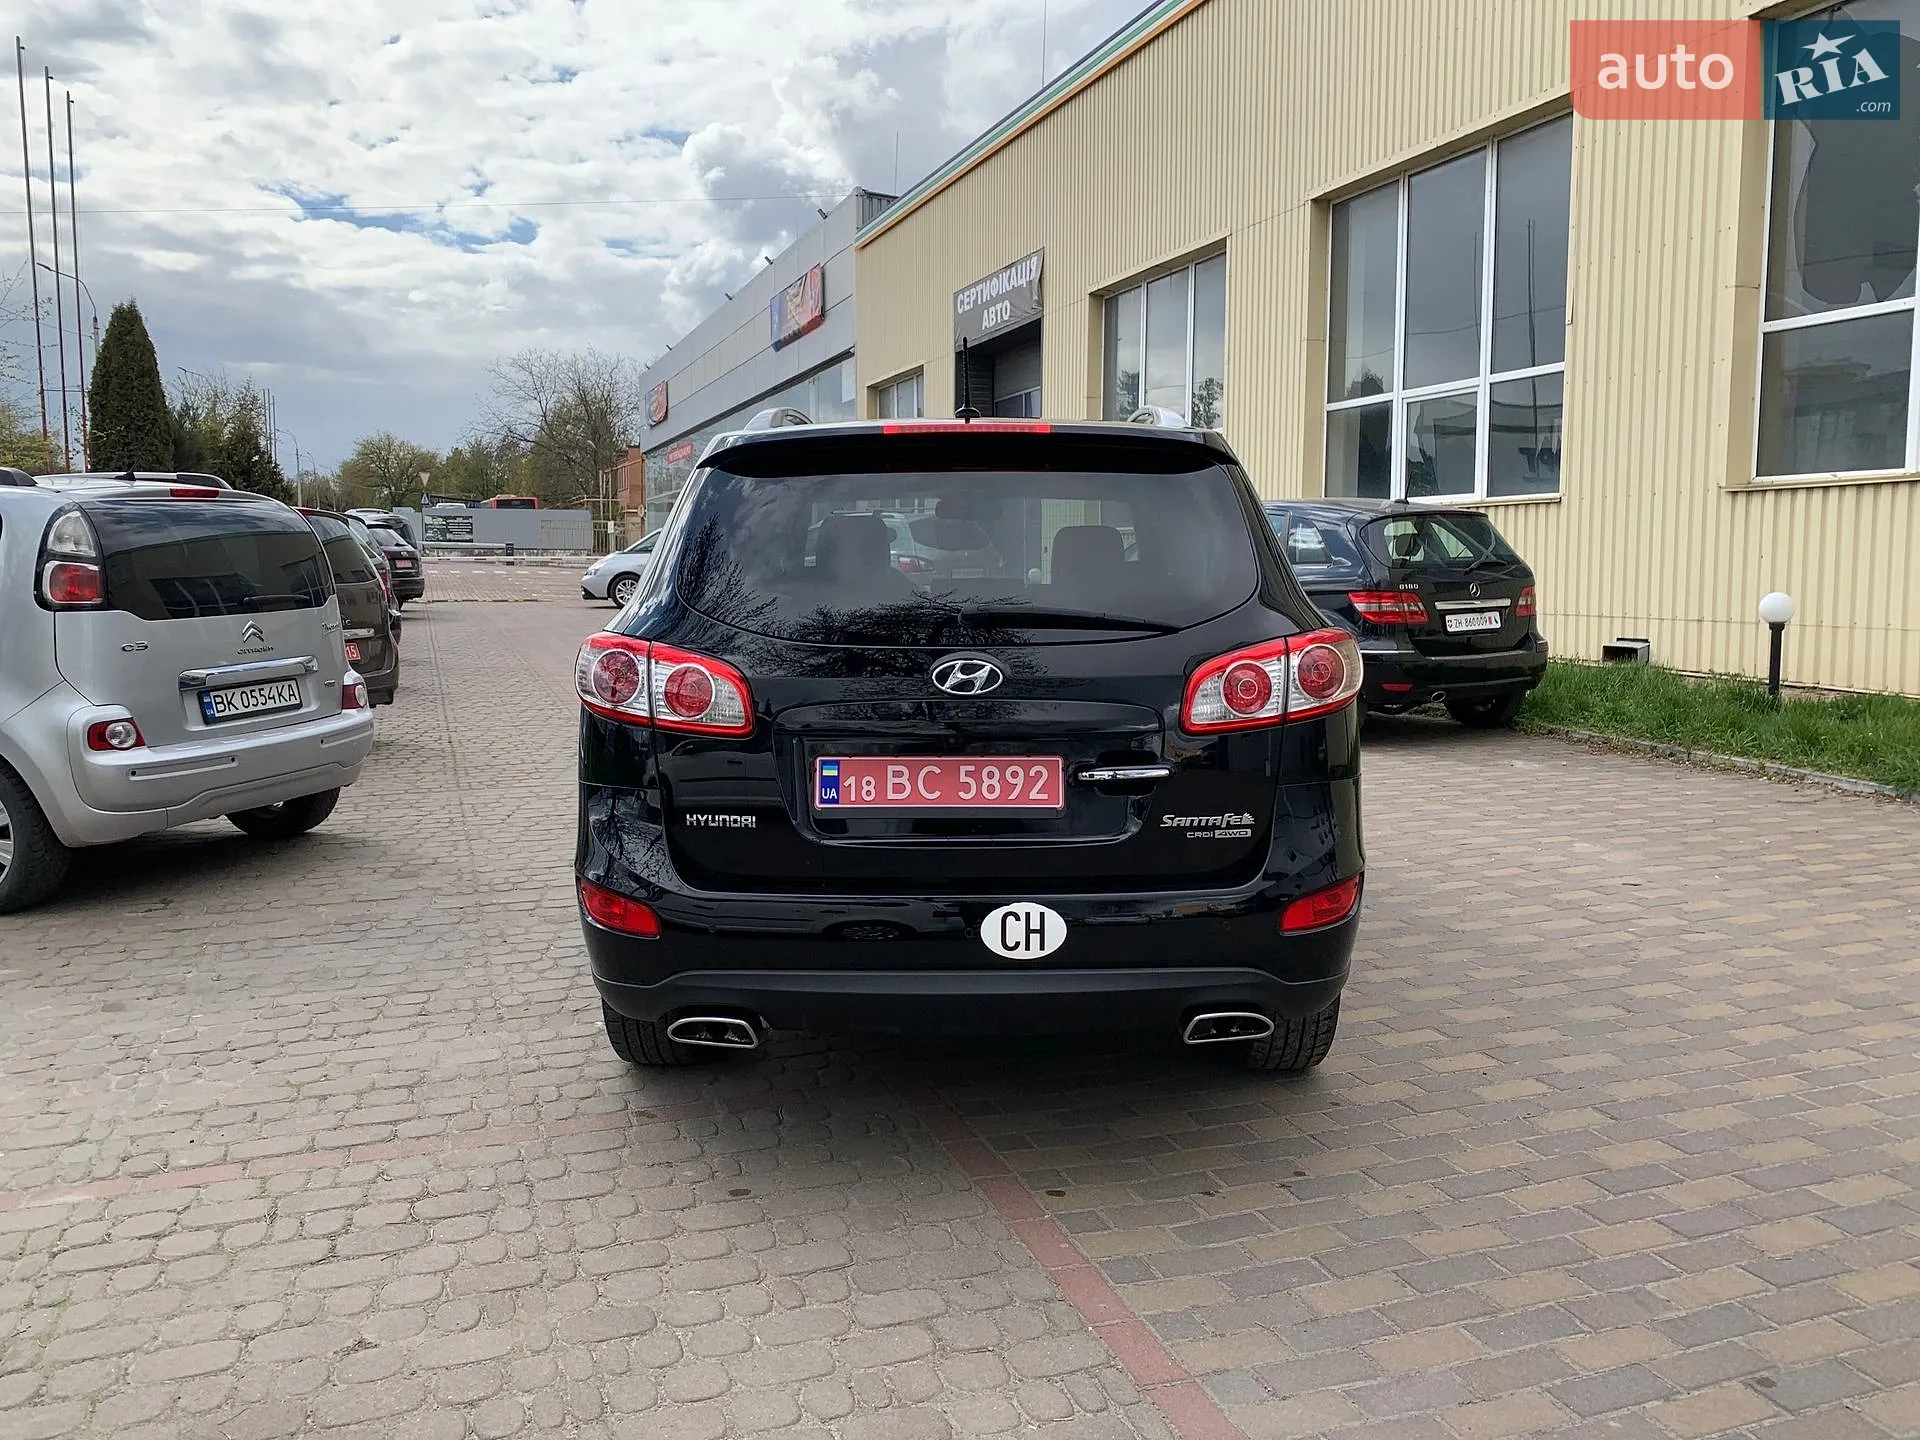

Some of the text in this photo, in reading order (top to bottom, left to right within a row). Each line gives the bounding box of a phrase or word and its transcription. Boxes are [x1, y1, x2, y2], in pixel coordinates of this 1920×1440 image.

[957, 256, 1038, 314] СЕРТИФІКАЦІЯ
[982, 300, 1010, 330] АВТО
[121, 640, 149, 652] C3
[212, 690, 240, 714] BK
[821, 787, 838, 800] UA
[843, 765, 1050, 801] 18 BC 5892
[686, 814, 756, 828] HYUNDAI
[1001, 911, 1045, 951] CH
